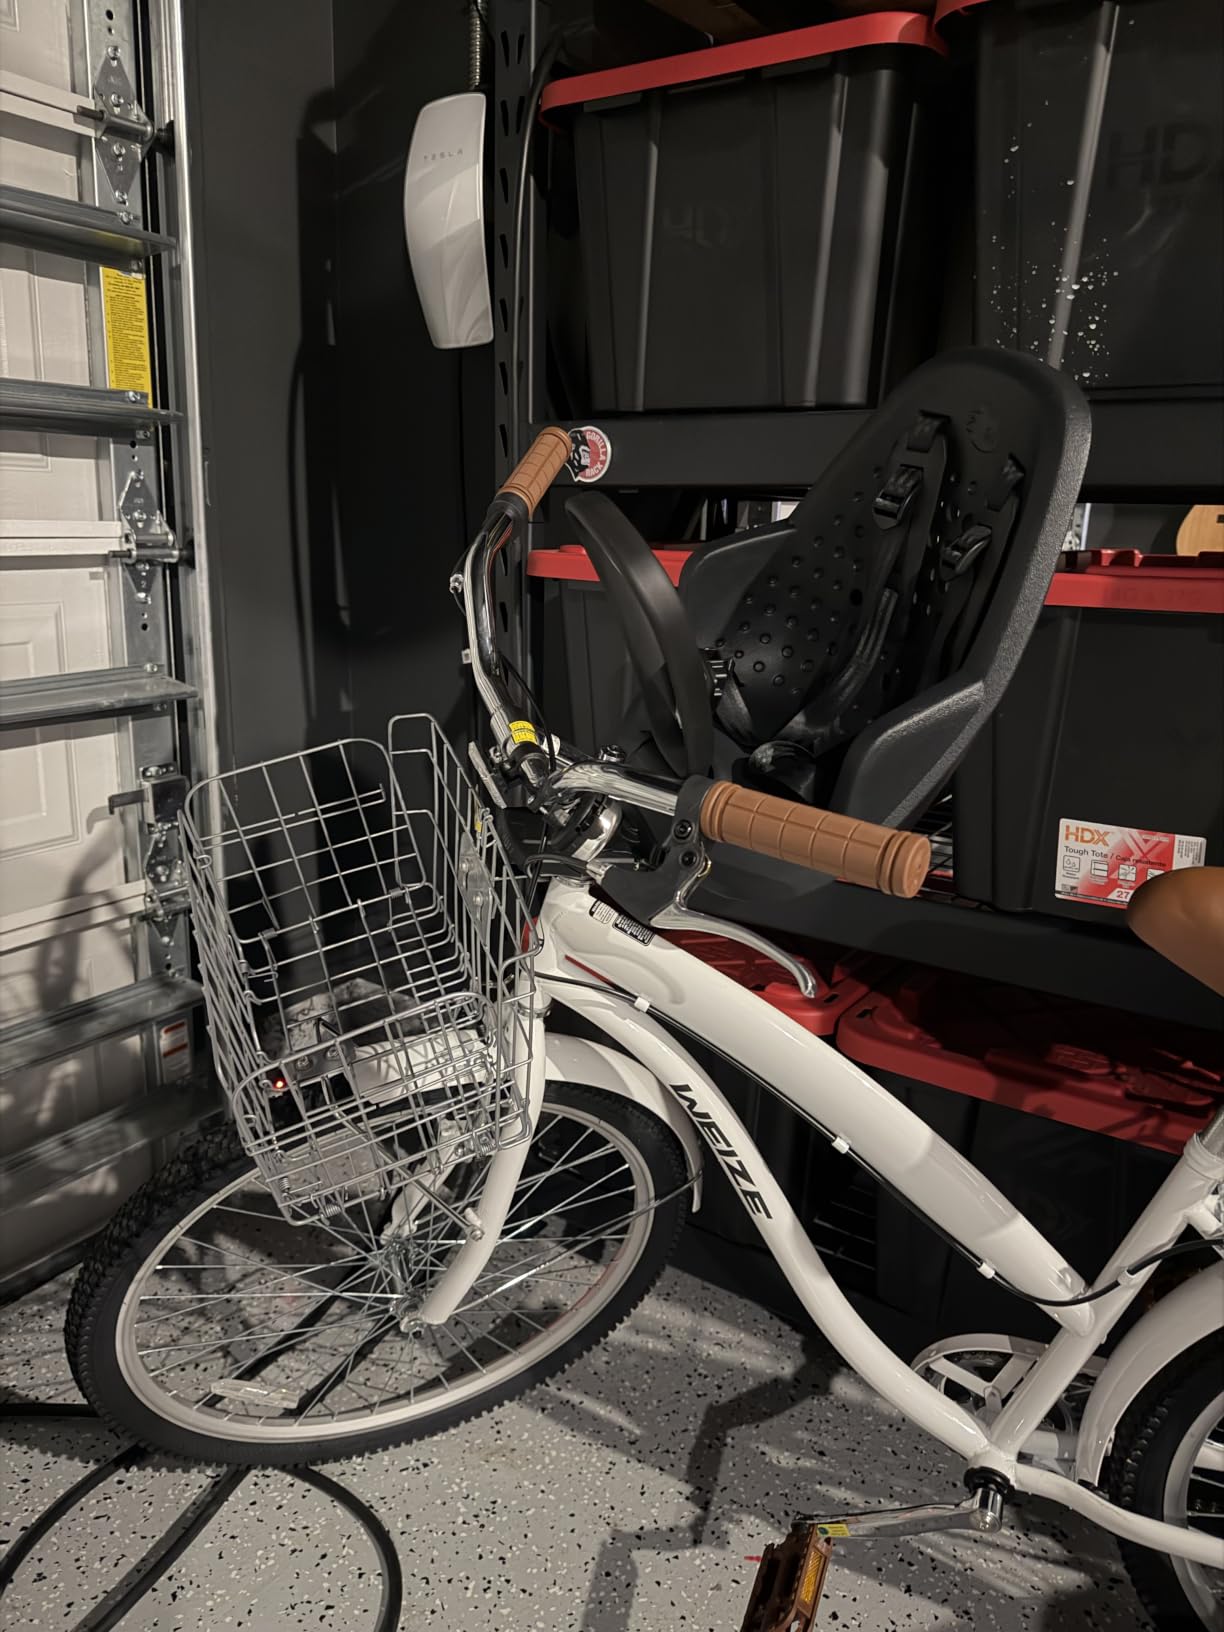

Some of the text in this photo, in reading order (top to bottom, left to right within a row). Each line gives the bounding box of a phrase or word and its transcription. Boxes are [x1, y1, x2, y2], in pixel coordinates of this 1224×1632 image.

[423, 148, 463, 160] TESLA
[1106, 122, 1224, 191] HD
[586, 431, 607, 461] GORILLA
[585, 461, 603, 477] RACK
[1065, 825, 1110, 846] HDX
[1064, 846, 1089, 856] Tough
[1091, 850, 1108, 859] Tote
[1116, 890, 1130, 900] 27
[669, 1084, 773, 1219] WEIZE
